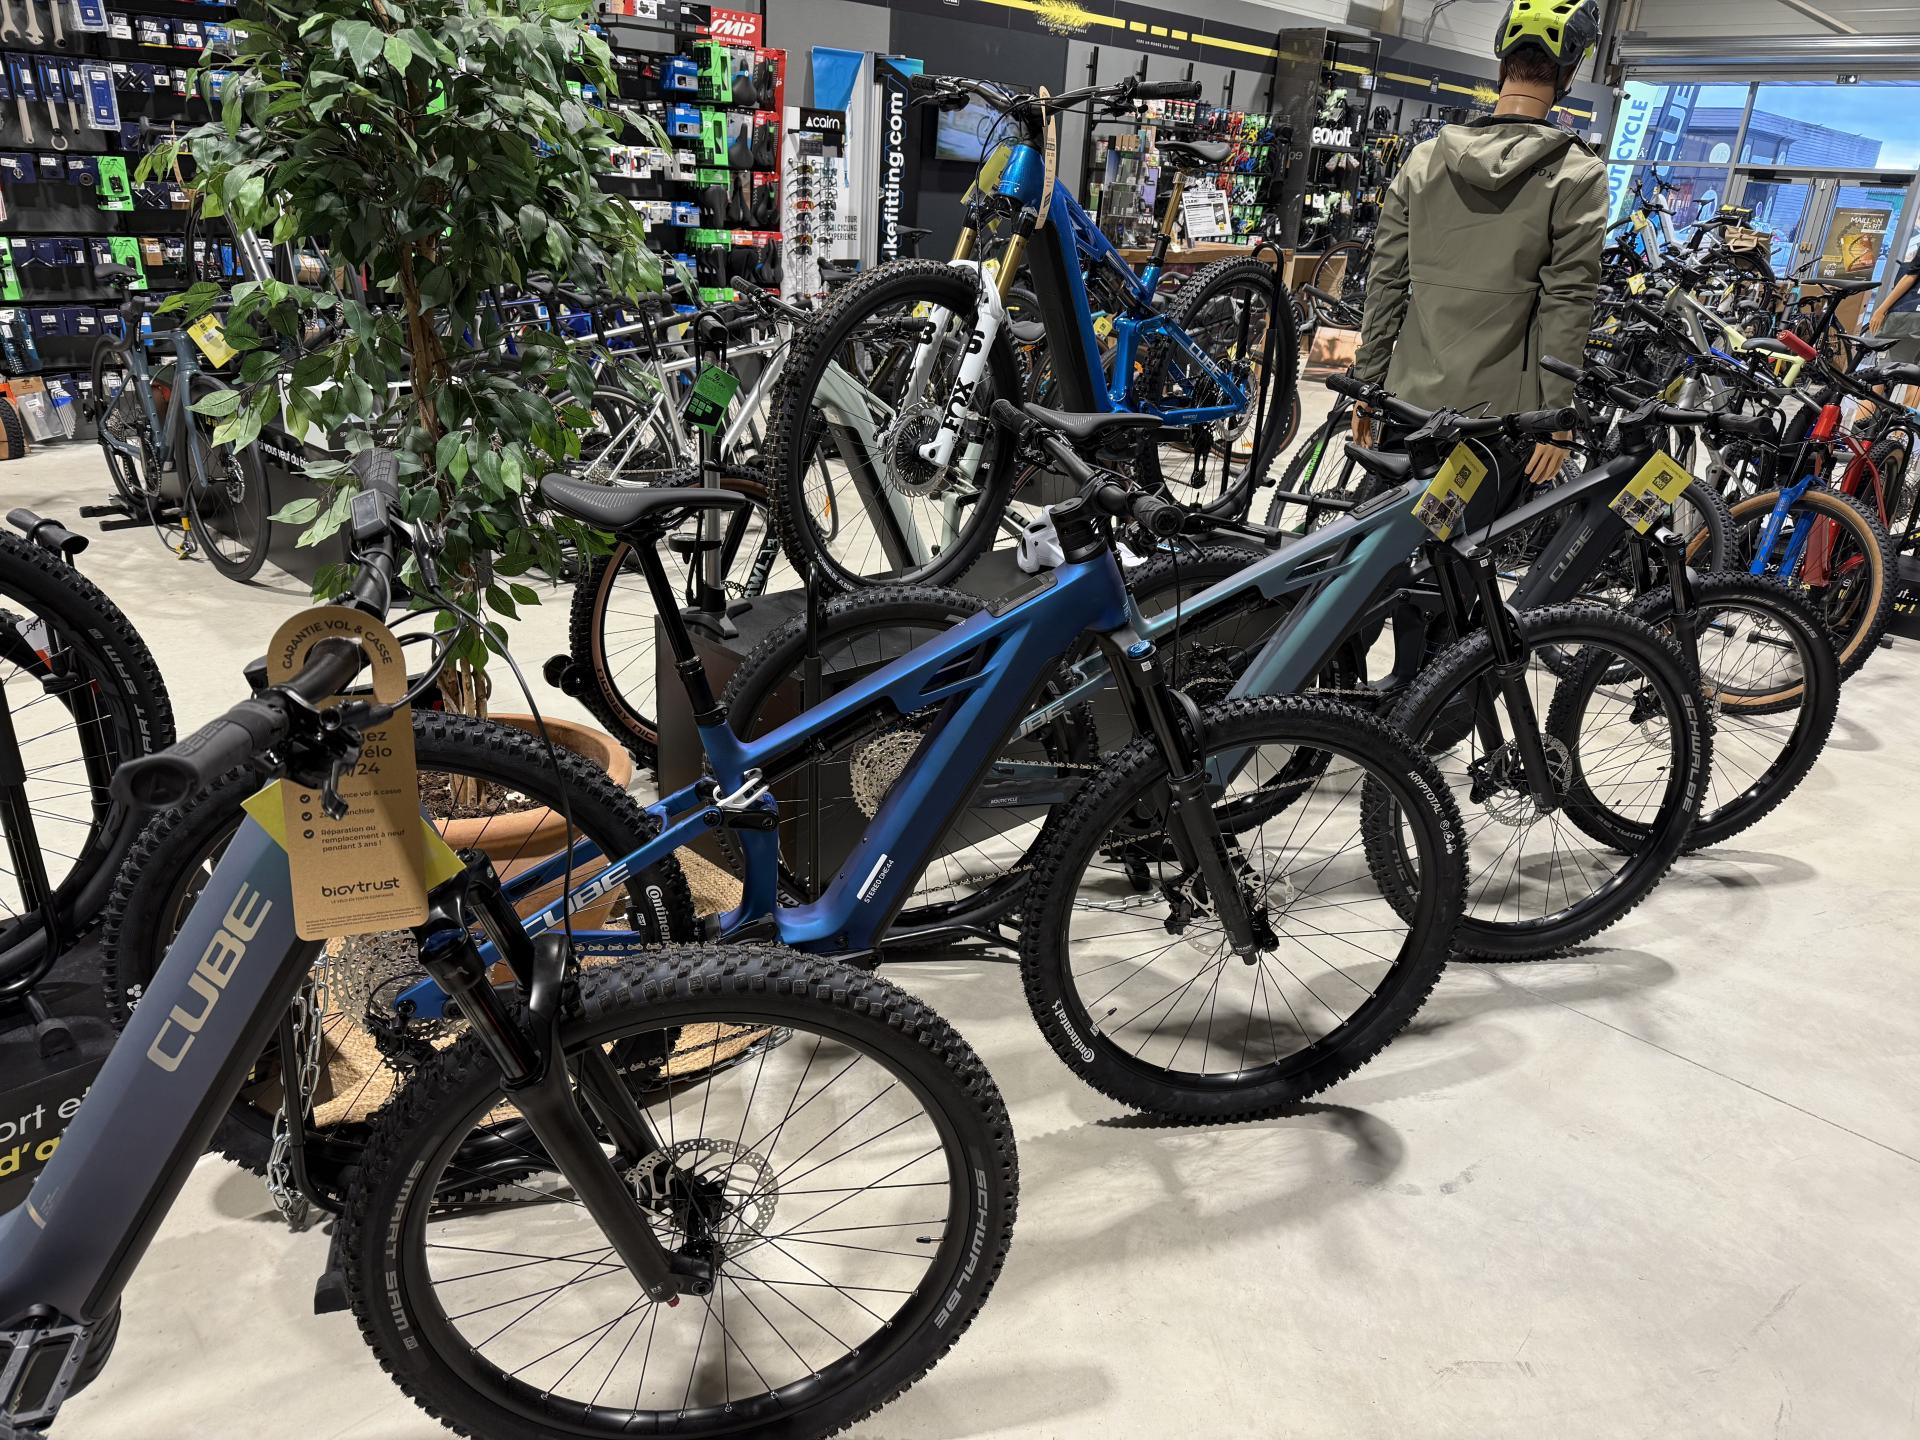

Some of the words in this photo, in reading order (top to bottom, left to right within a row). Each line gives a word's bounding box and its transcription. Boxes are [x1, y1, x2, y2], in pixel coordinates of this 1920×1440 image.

[704, 18, 756, 37] SMP
[712, 11, 756, 23] SELLE
[812, 115, 841, 130] cairn
[1312, 127, 1352, 147] eovolt
[883, 92, 904, 257] ikefitting.com
[1188, 342, 1224, 379] CUBE
[941, 376, 975, 435] FOX
[263, 441, 277, 456] vous
[278, 449, 290, 462] veut
[1549, 525, 1595, 583] CUBE
[283, 621, 323, 670] GARANTIE
[324, 620, 351, 632] VOL
[354, 625, 362, 634] &
[364, 631, 393, 665] CASSE
[102, 644, 138, 695] SAM
[1681, 693, 1701, 813] SCHWALBE
[1408, 770, 1443, 814] KRYPTOTAL
[321, 825, 364, 838] Réparation
[322, 833, 379, 844] remplacement
[387, 829, 405, 837] neuf
[323, 843, 356, 854] pendant
[863, 879, 882, 904] STEREO
[147, 881, 272, 1072] CUBE
[1054, 1005, 1095, 1063] Continental
[385, 1160, 425, 1259] SMART
[934, 1168, 988, 1329] SCHWALBE
[386, 1271, 409, 1331] SAM
